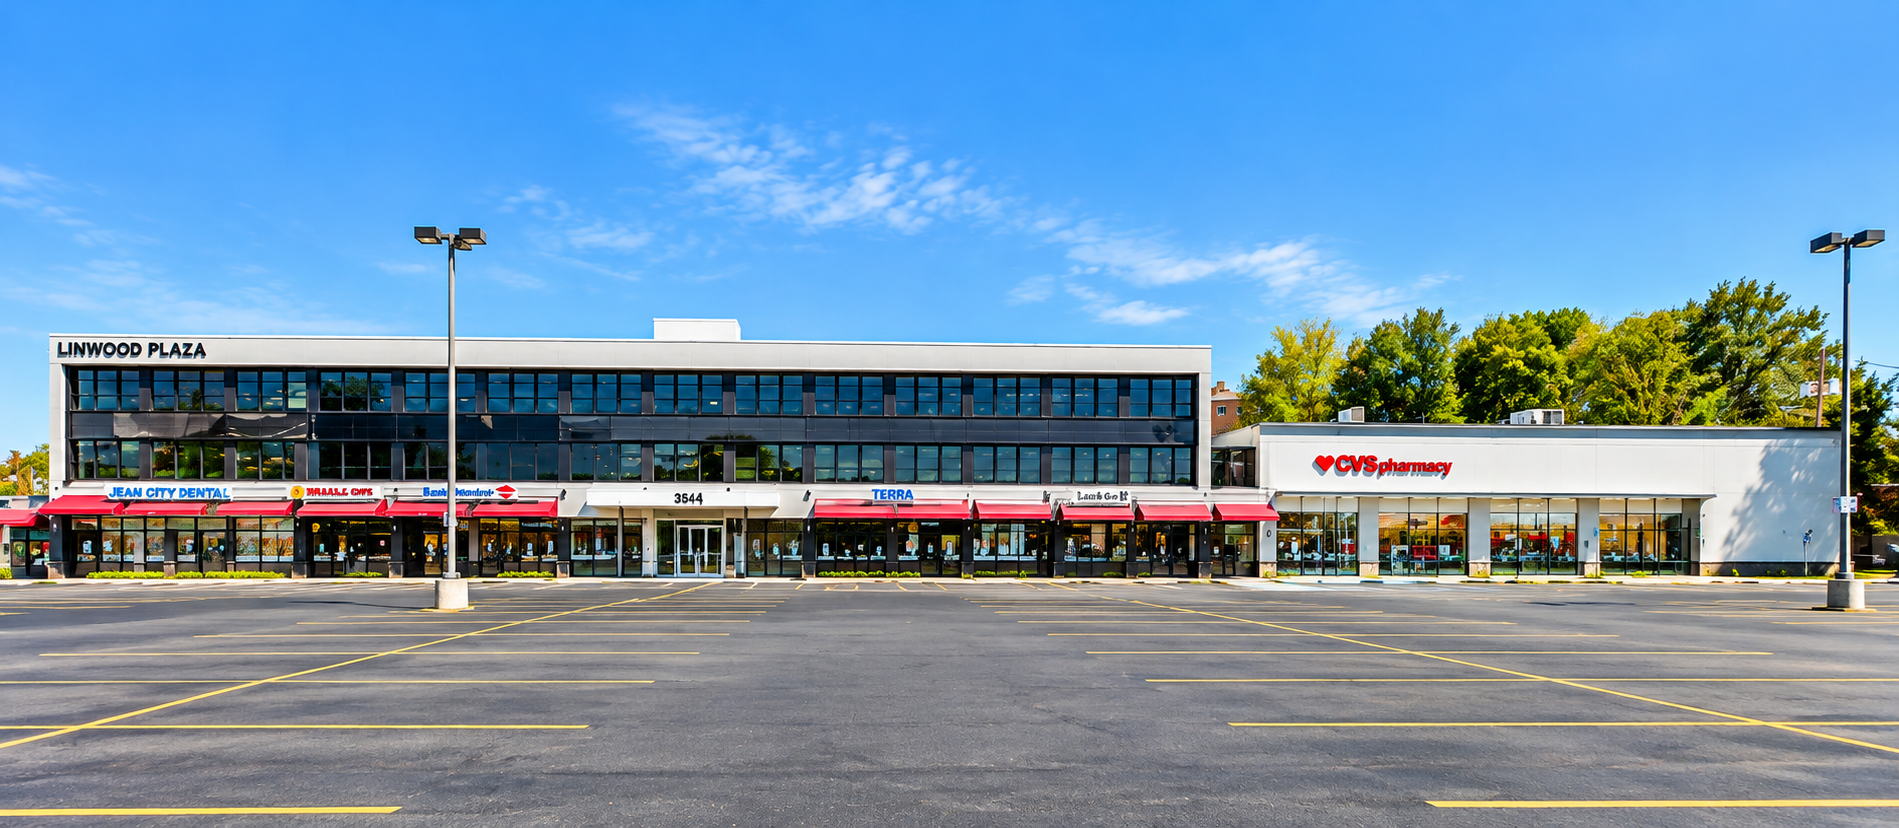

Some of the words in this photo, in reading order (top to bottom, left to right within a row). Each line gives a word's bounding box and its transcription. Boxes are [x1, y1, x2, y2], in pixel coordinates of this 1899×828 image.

[57, 341, 142, 358] LINWOOD
[148, 342, 206, 358] PLAZA
[1335, 454, 1378, 473] CVS
[1378, 458, 1453, 476] pharmacy
[109, 487, 142, 498] JEAN
[146, 487, 176, 498] CITY
[179, 487, 230, 499] DENTAL
[872, 489, 914, 500] TERRA
